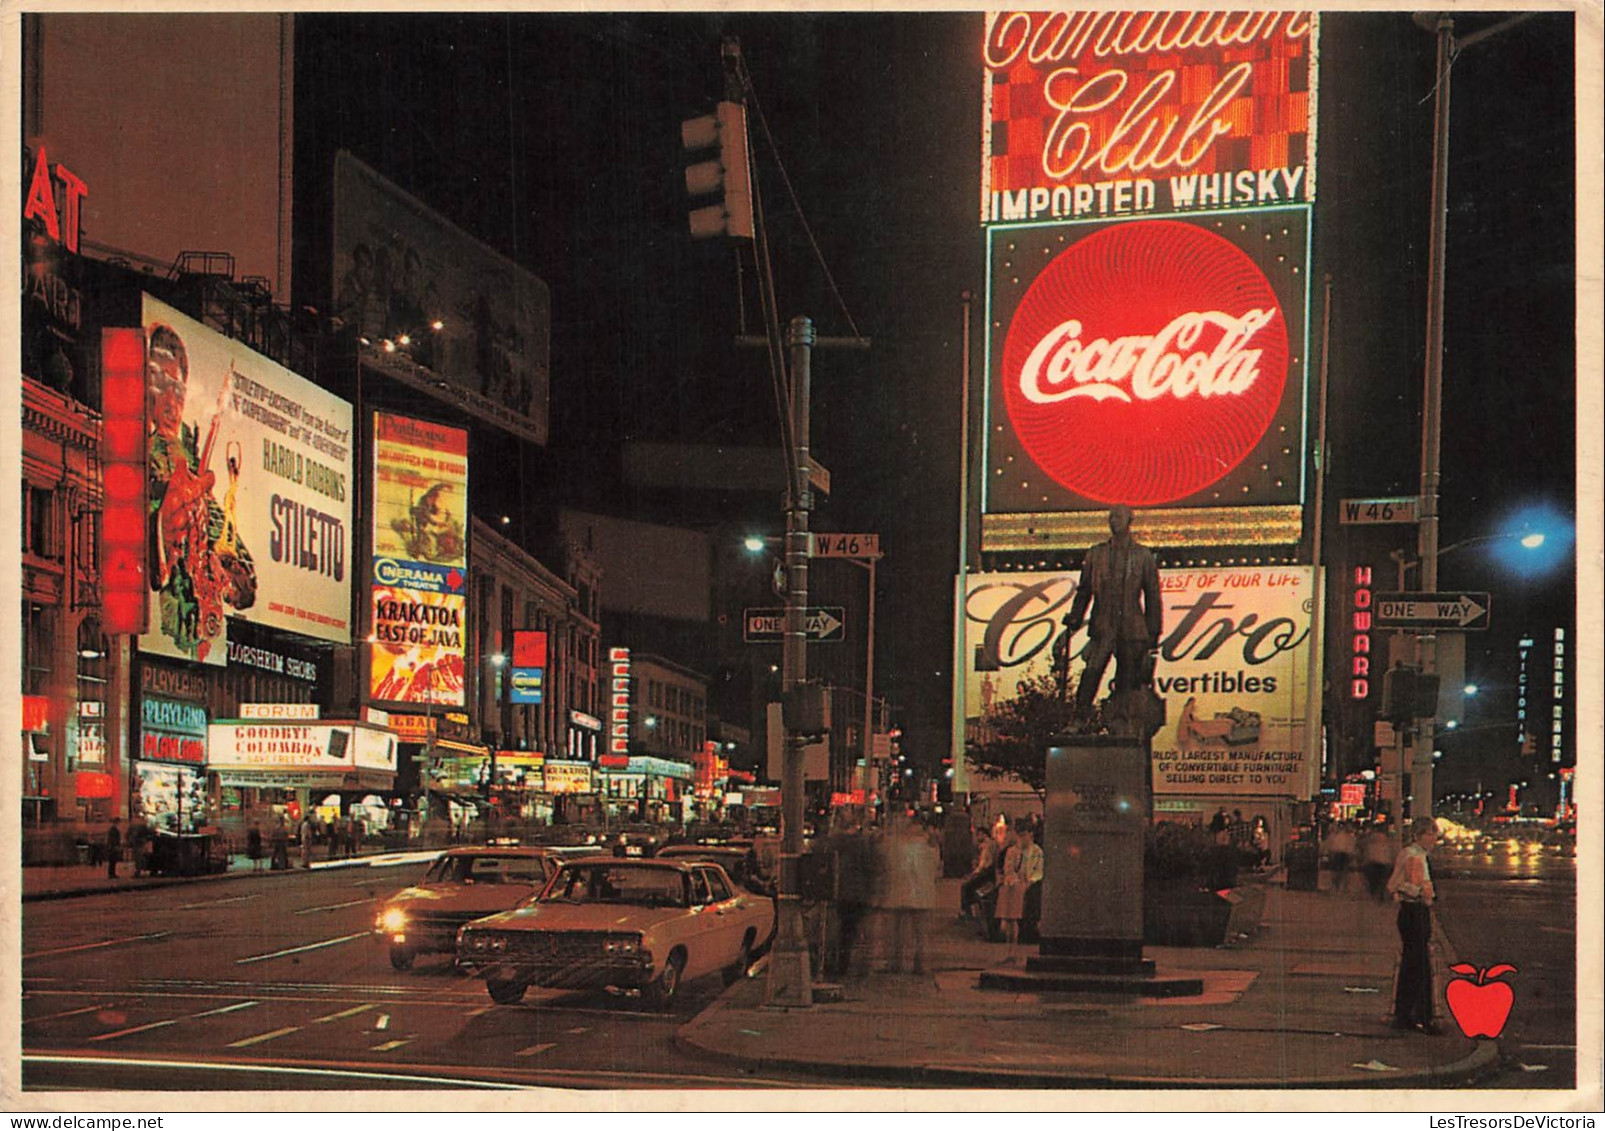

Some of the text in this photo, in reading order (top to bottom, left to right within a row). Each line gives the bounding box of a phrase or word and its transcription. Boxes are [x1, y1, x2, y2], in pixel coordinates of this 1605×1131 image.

[1043, 62, 1252, 179] Club
[991, 166, 1304, 221] IMPORTED WHISKY
[1019, 307, 1276, 404] Coca-Cola
[263, 438, 303, 486] HAROLD
[306, 457, 346, 503] ROBBINS
[1346, 503, 1359, 521] W
[1366, 503, 1394, 521] 46
[270, 493, 344, 582] STILETTO
[817, 536, 831, 555] W
[836, 536, 860, 555] 46
[375, 558, 443, 585] CINERAMA
[1197, 574, 1217, 588] OF
[1223, 574, 1261, 588] YOUR
[1267, 573, 1300, 587] LIFE
[377, 600, 460, 628] KRAKATOA
[1383, 603, 1470, 617] ONE WAY
[376, 623, 462, 648] EAST OF JAVA
[753, 617, 781, 631] ONE
[1352, 566, 1372, 700] HOWARD
[1517, 651, 1528, 742] VICTORIA
[144, 699, 208, 729] PLAYLAND
[245, 705, 315, 718] FORUM
[144, 732, 205, 762] PLAYLAND
[235, 741, 324, 758] COLUMBUS
[1181, 751, 1225, 761] LARGEST
[1159, 762, 1300, 773] OF CONVERTIBLE FURNITURE
[1165, 773, 1287, 784] SELLING DIRECT TO YOU
